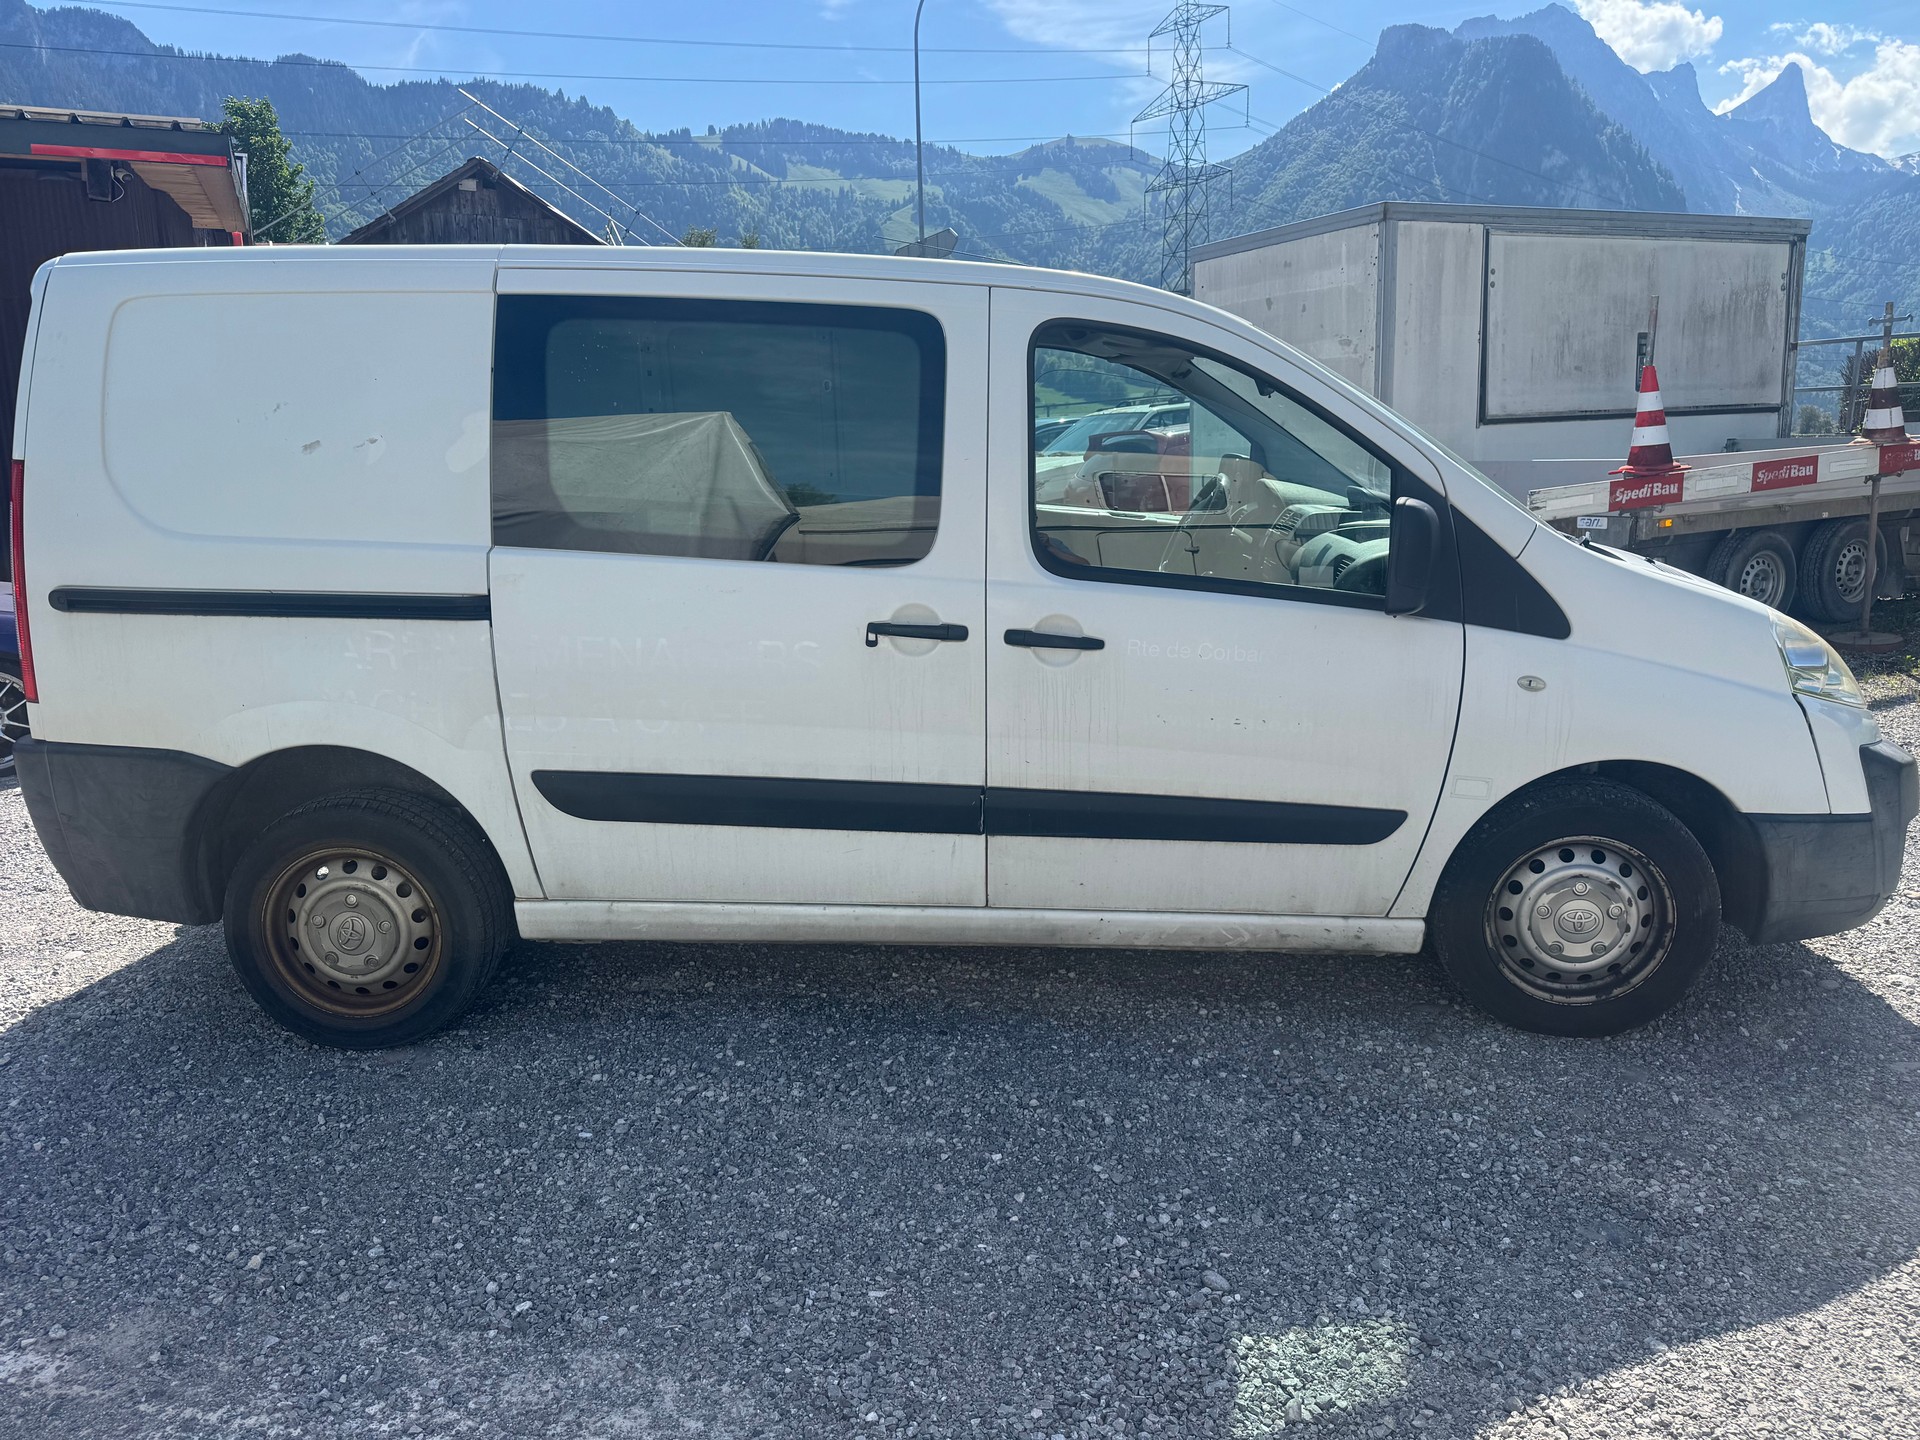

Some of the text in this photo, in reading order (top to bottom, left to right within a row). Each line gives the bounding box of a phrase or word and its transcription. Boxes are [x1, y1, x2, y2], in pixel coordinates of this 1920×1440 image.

[1614, 482, 1678, 504] SpediBau
[1127, 639, 1160, 657] Rte
[1166, 640, 1191, 658] de
